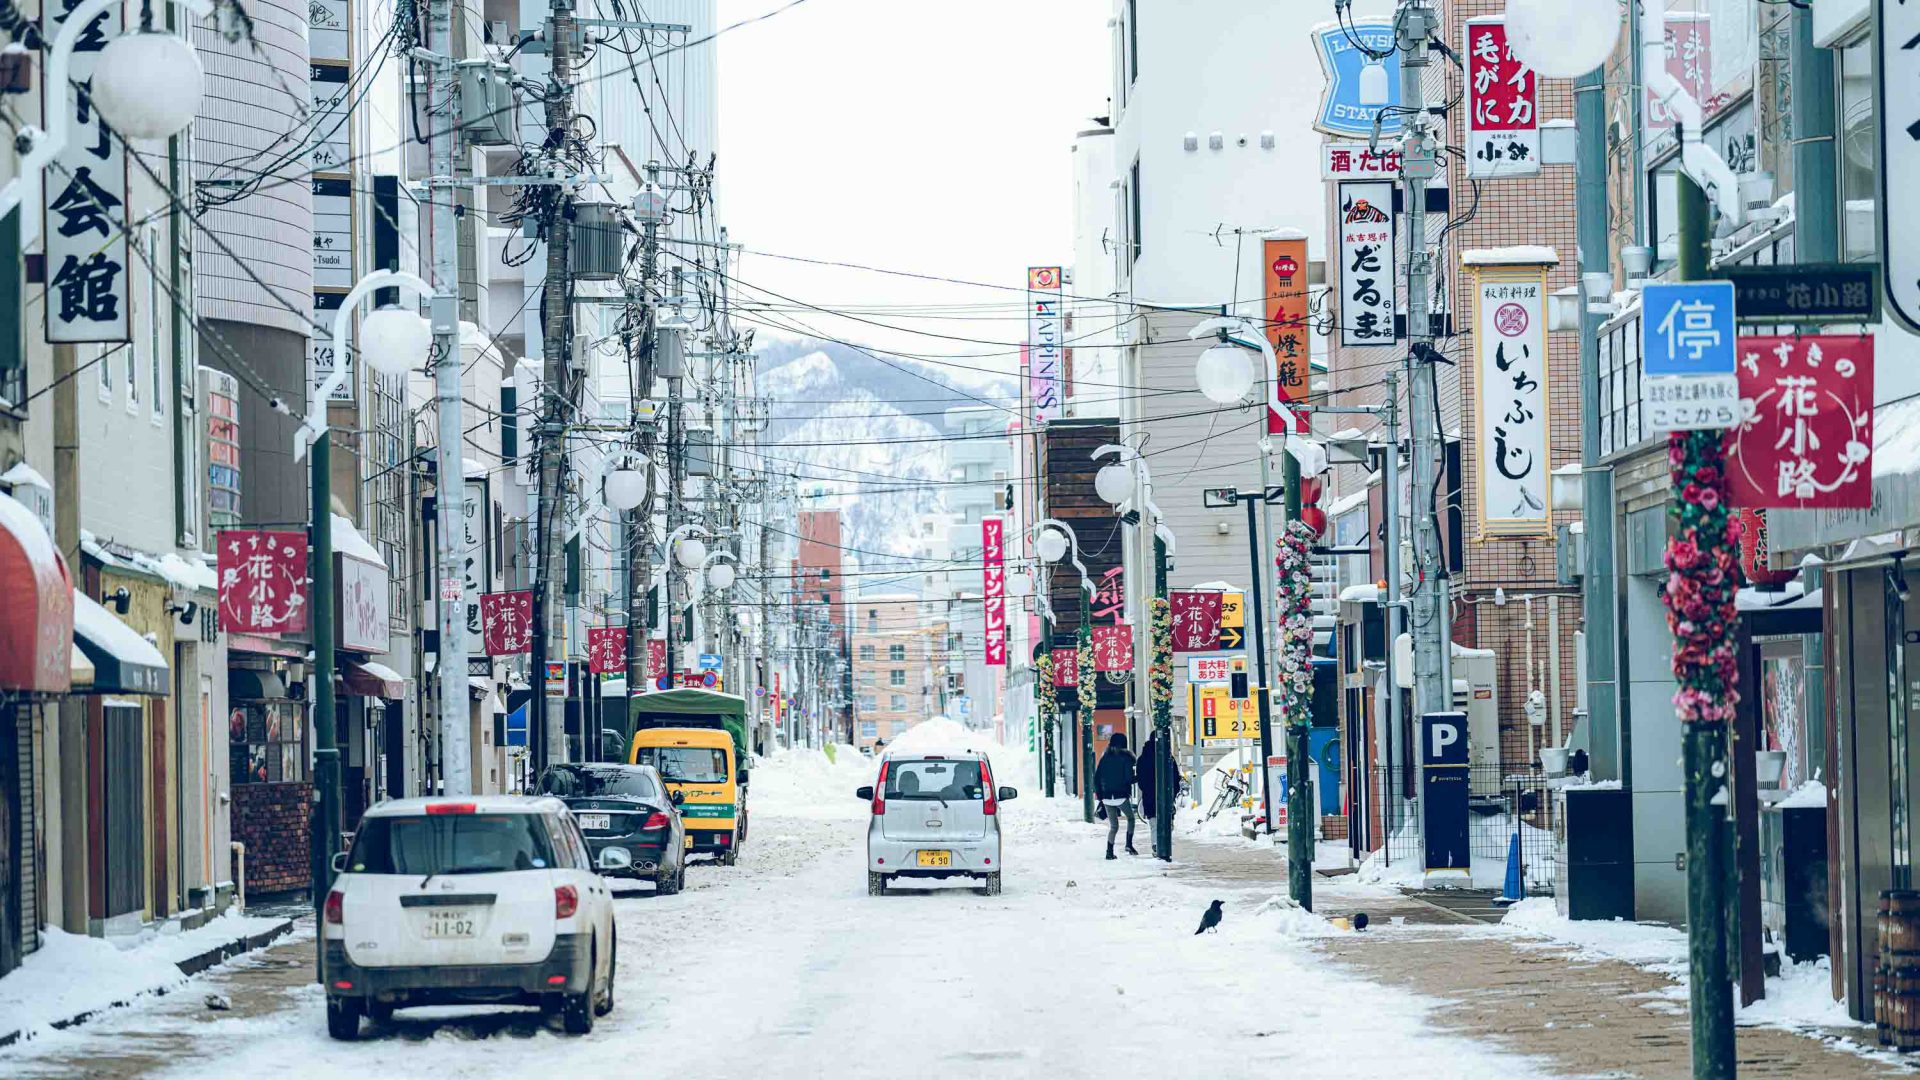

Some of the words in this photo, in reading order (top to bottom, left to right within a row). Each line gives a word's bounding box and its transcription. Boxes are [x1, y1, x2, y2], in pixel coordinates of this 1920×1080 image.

[1472, 31, 1502, 126] 毛がに
[1330, 149, 1403, 173] 酒・たば
[316, 254, 341, 266] Tsudoi
[1350, 243, 1382, 339] だるま
[1656, 298, 1721, 361] 停
[1035, 300, 1059, 410] HAPPINESS
[1741, 341, 1856, 379] すすきの
[1495, 340, 1538, 481] いちふじ
[1653, 405, 1734, 426] ここから
[1774, 375, 1820, 499] 花小路
[248, 554, 275, 627] 花小路
[500, 607, 518, 652] 花小路
[1187, 605, 1203, 649] 花小路
[602, 638, 614, 670] 花小路
[1198, 660, 1229, 670] 最大料
[1198, 670, 1229, 680] ありま
[1431, 723, 1458, 758] P
